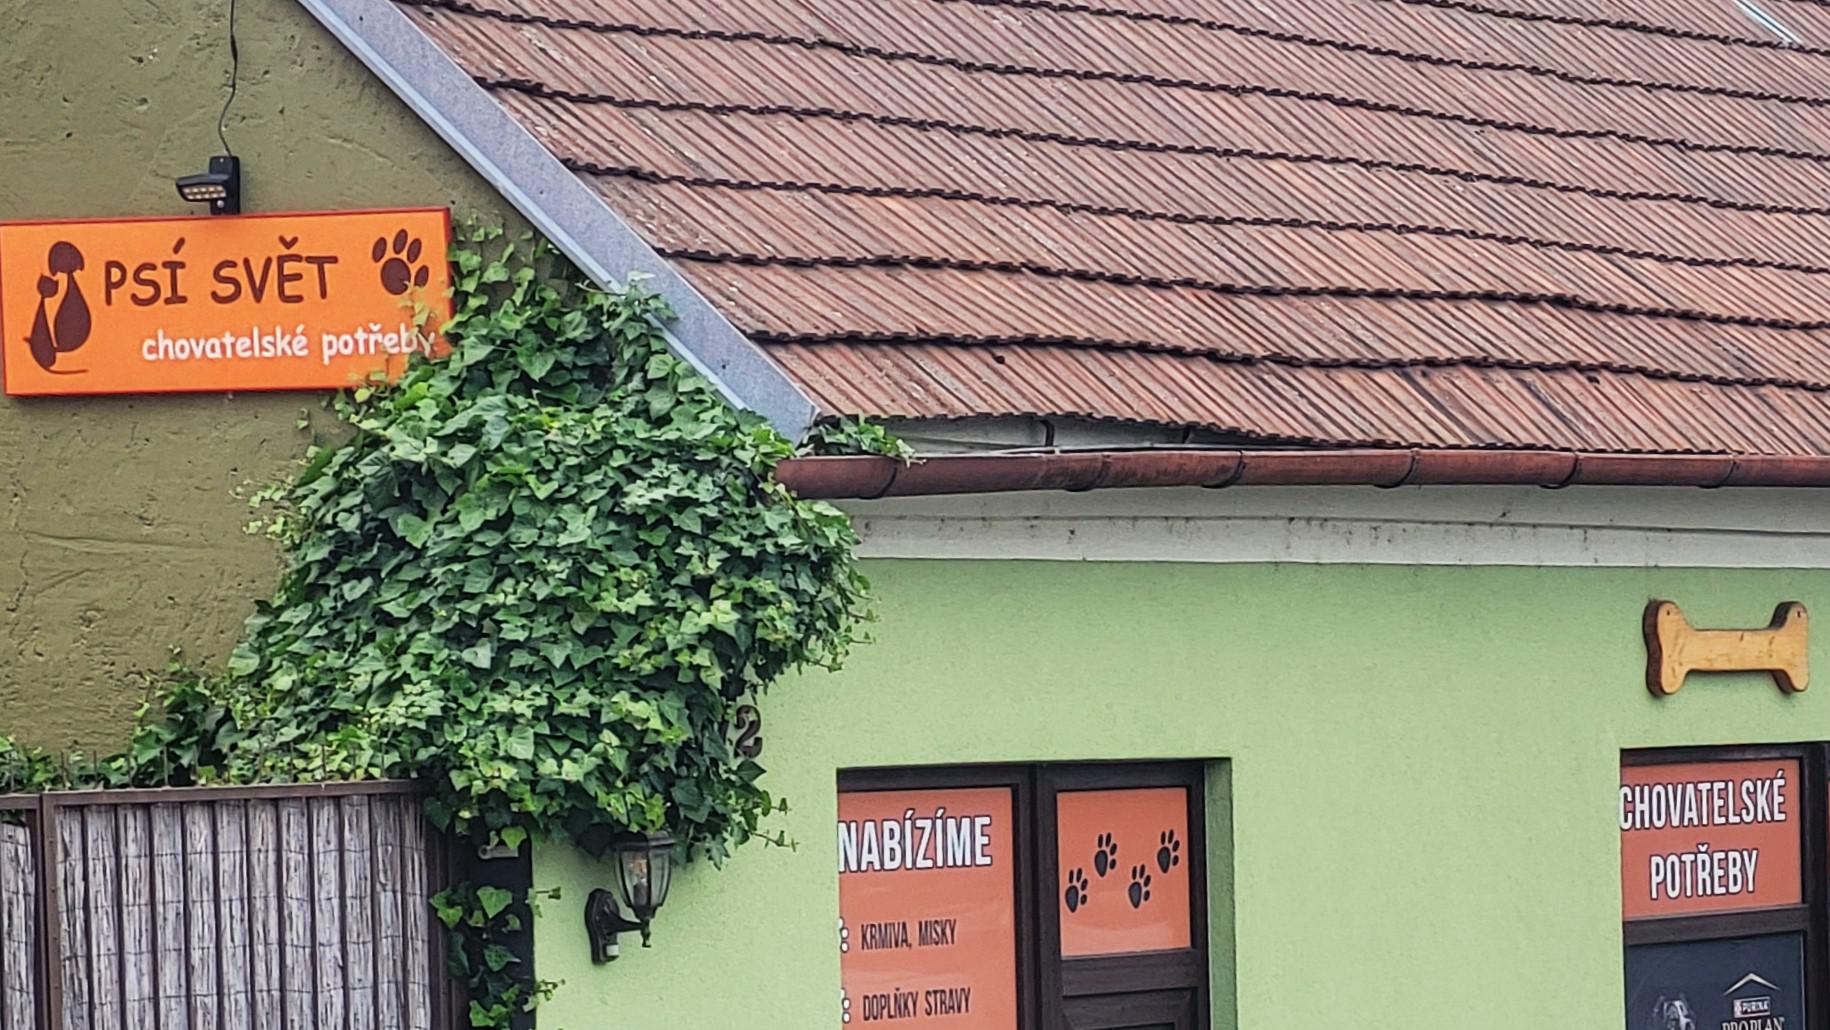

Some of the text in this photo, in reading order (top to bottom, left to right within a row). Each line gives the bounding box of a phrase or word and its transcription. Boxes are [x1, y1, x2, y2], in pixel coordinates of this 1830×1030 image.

[104, 235, 339, 307] PSÍ SVĚT
[142, 322, 436, 365] chovatelské potřeby
[1619, 770, 1787, 831] CHOVATELSKÉ
[837, 806, 993, 874] NABÍZÍME
[1650, 843, 1758, 900] POTŘEBY
[861, 919, 957, 951] KRMIVA, MISKY
[862, 987, 971, 1021] DOPLŇKY STRAVY
